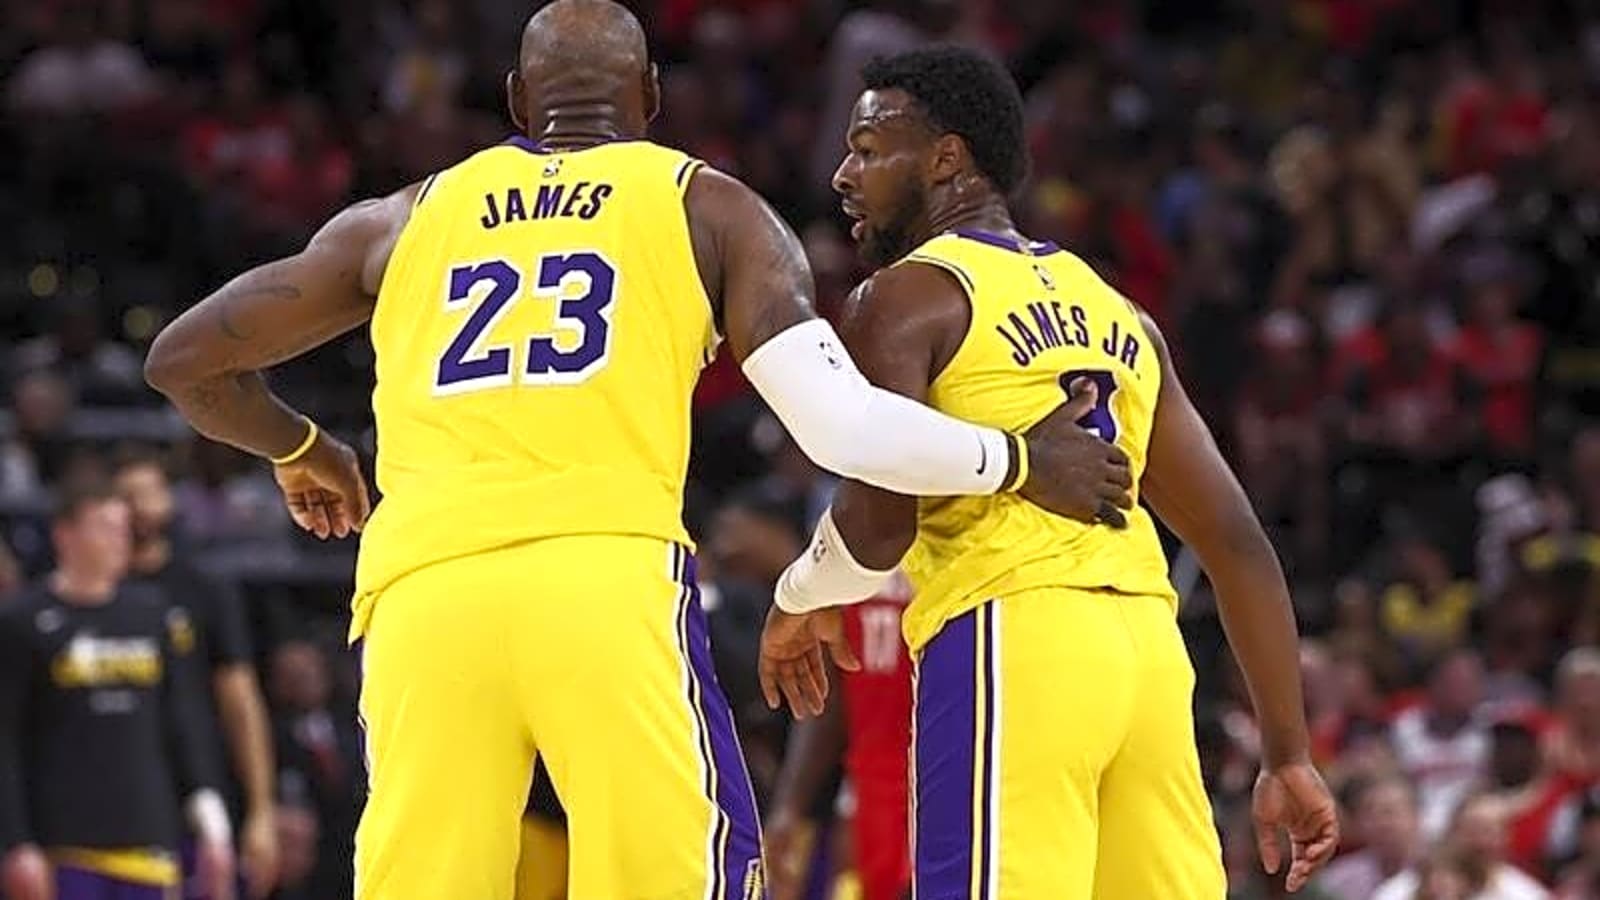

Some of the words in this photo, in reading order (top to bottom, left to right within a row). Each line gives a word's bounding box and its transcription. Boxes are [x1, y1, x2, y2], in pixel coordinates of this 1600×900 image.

[480, 182, 613, 229] JAMES
[435, 250, 617, 391] 23
[995, 301, 1090, 367] JAMES
